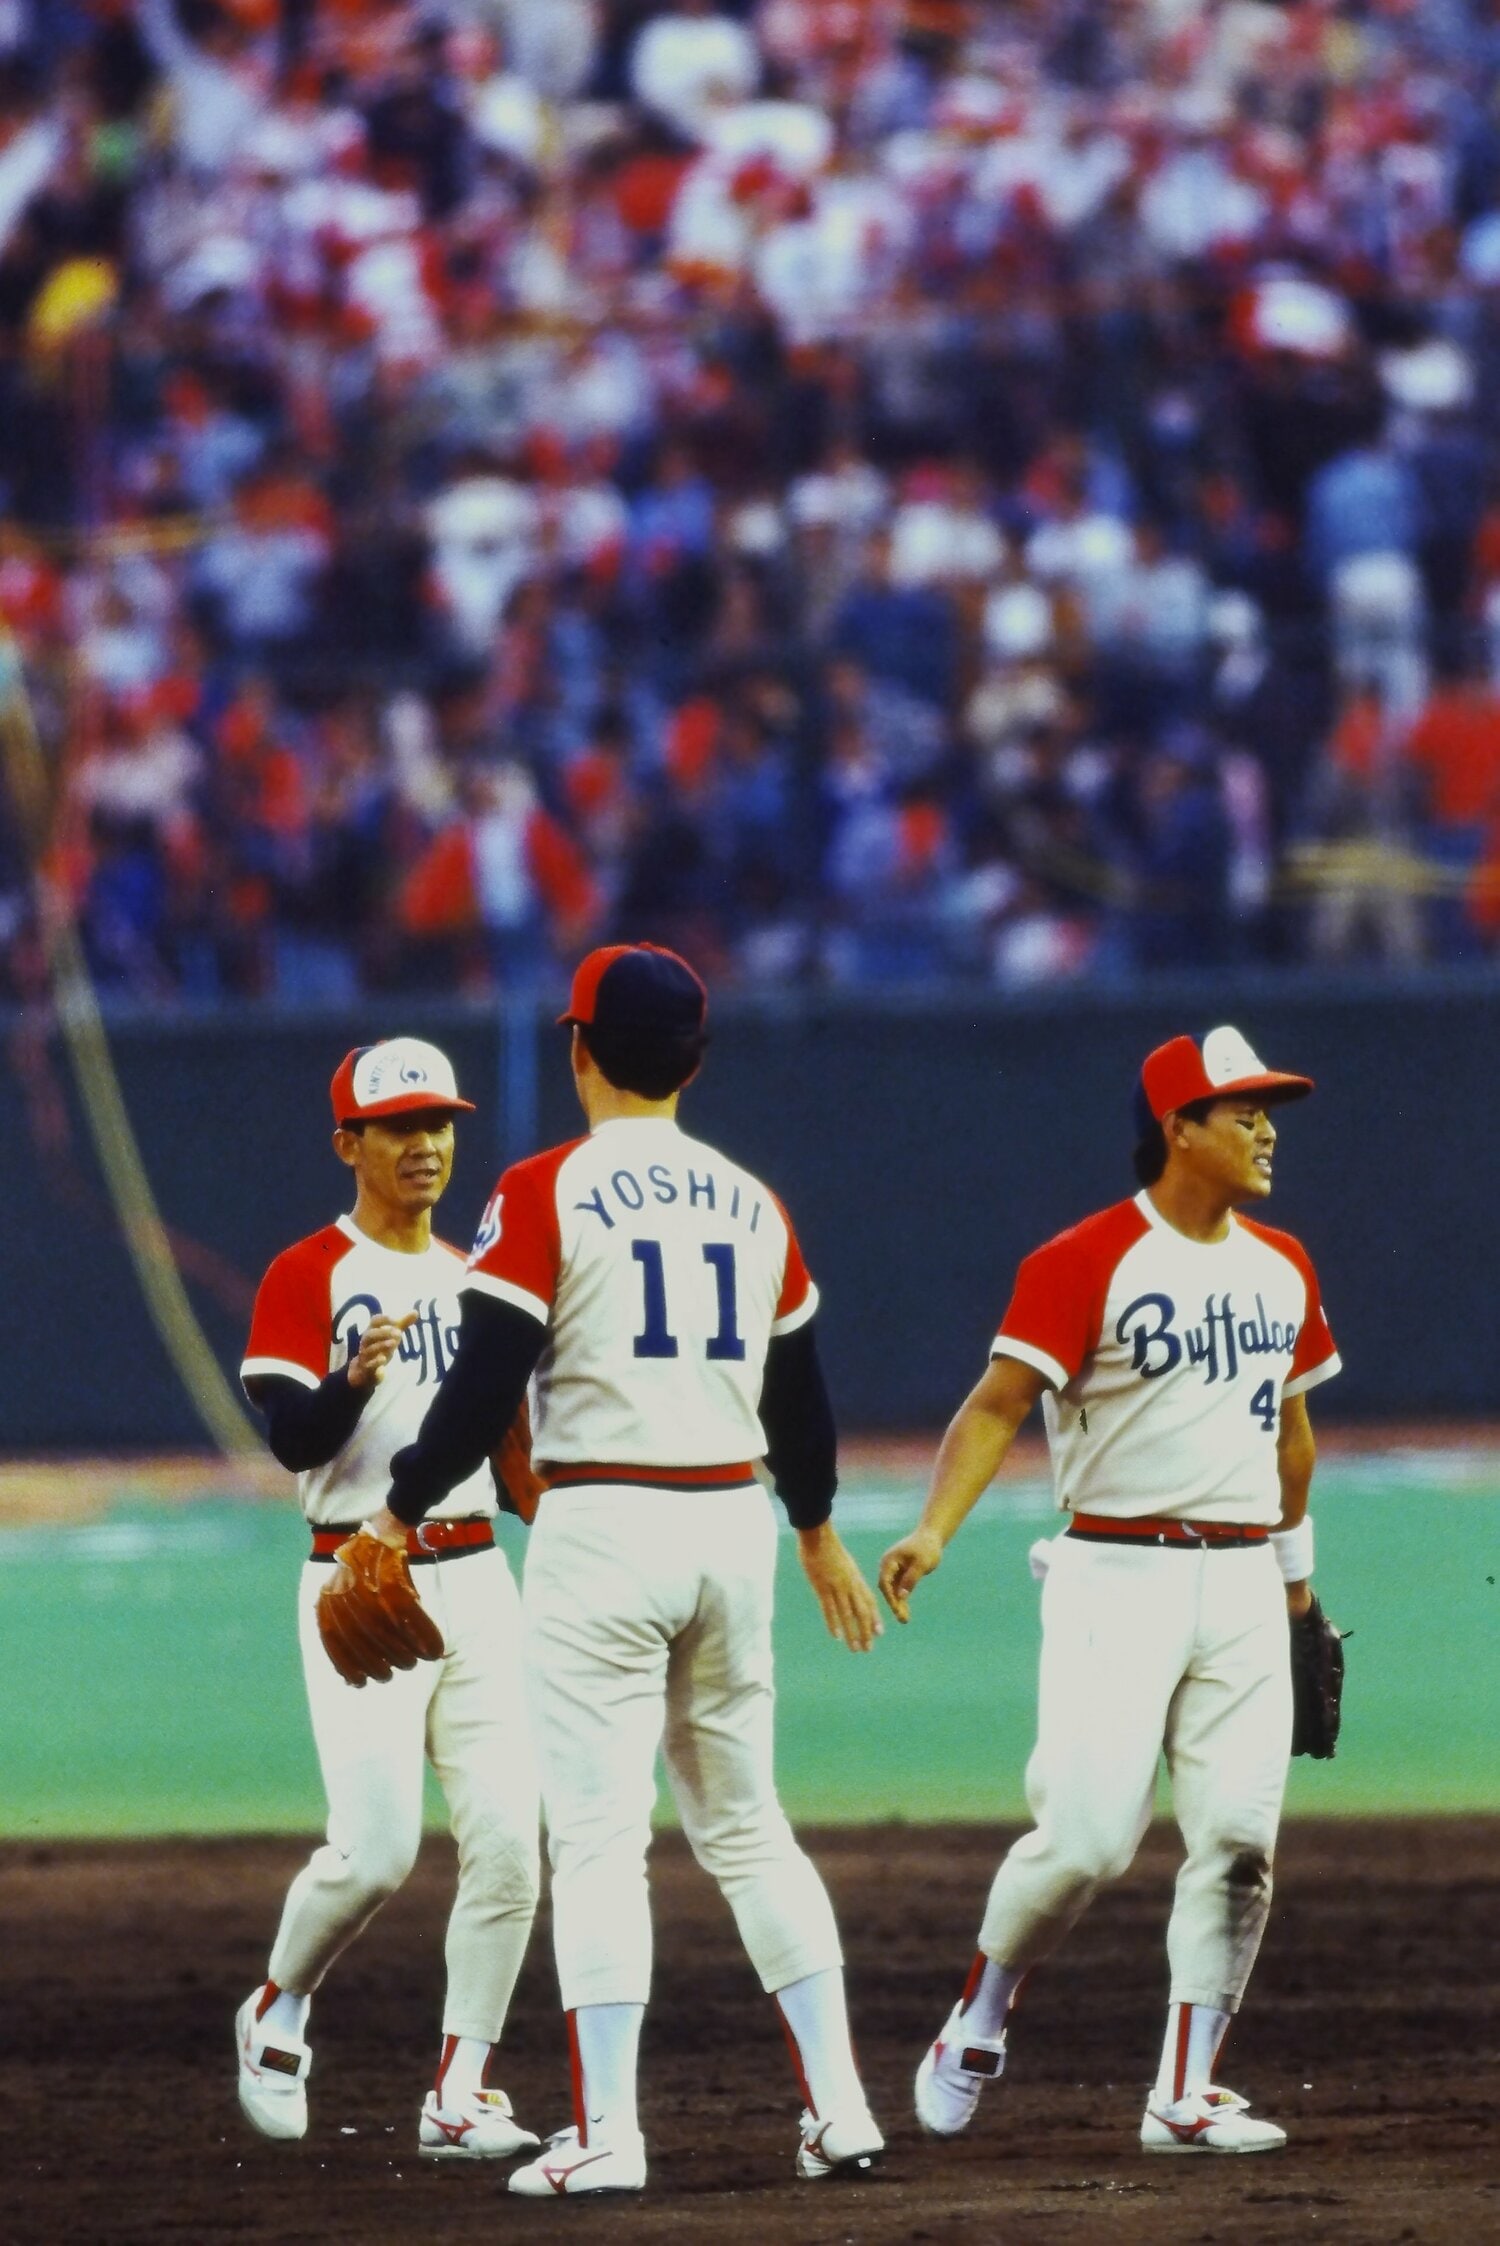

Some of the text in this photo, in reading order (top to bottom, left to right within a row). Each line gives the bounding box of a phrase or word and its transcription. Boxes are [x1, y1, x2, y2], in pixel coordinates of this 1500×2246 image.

[573, 1165, 761, 1234] YOSHII
[631, 1239, 746, 1361] 11
[1116, 1292, 1295, 1386] Buffaloe
[1250, 1378, 1276, 1432] 4
